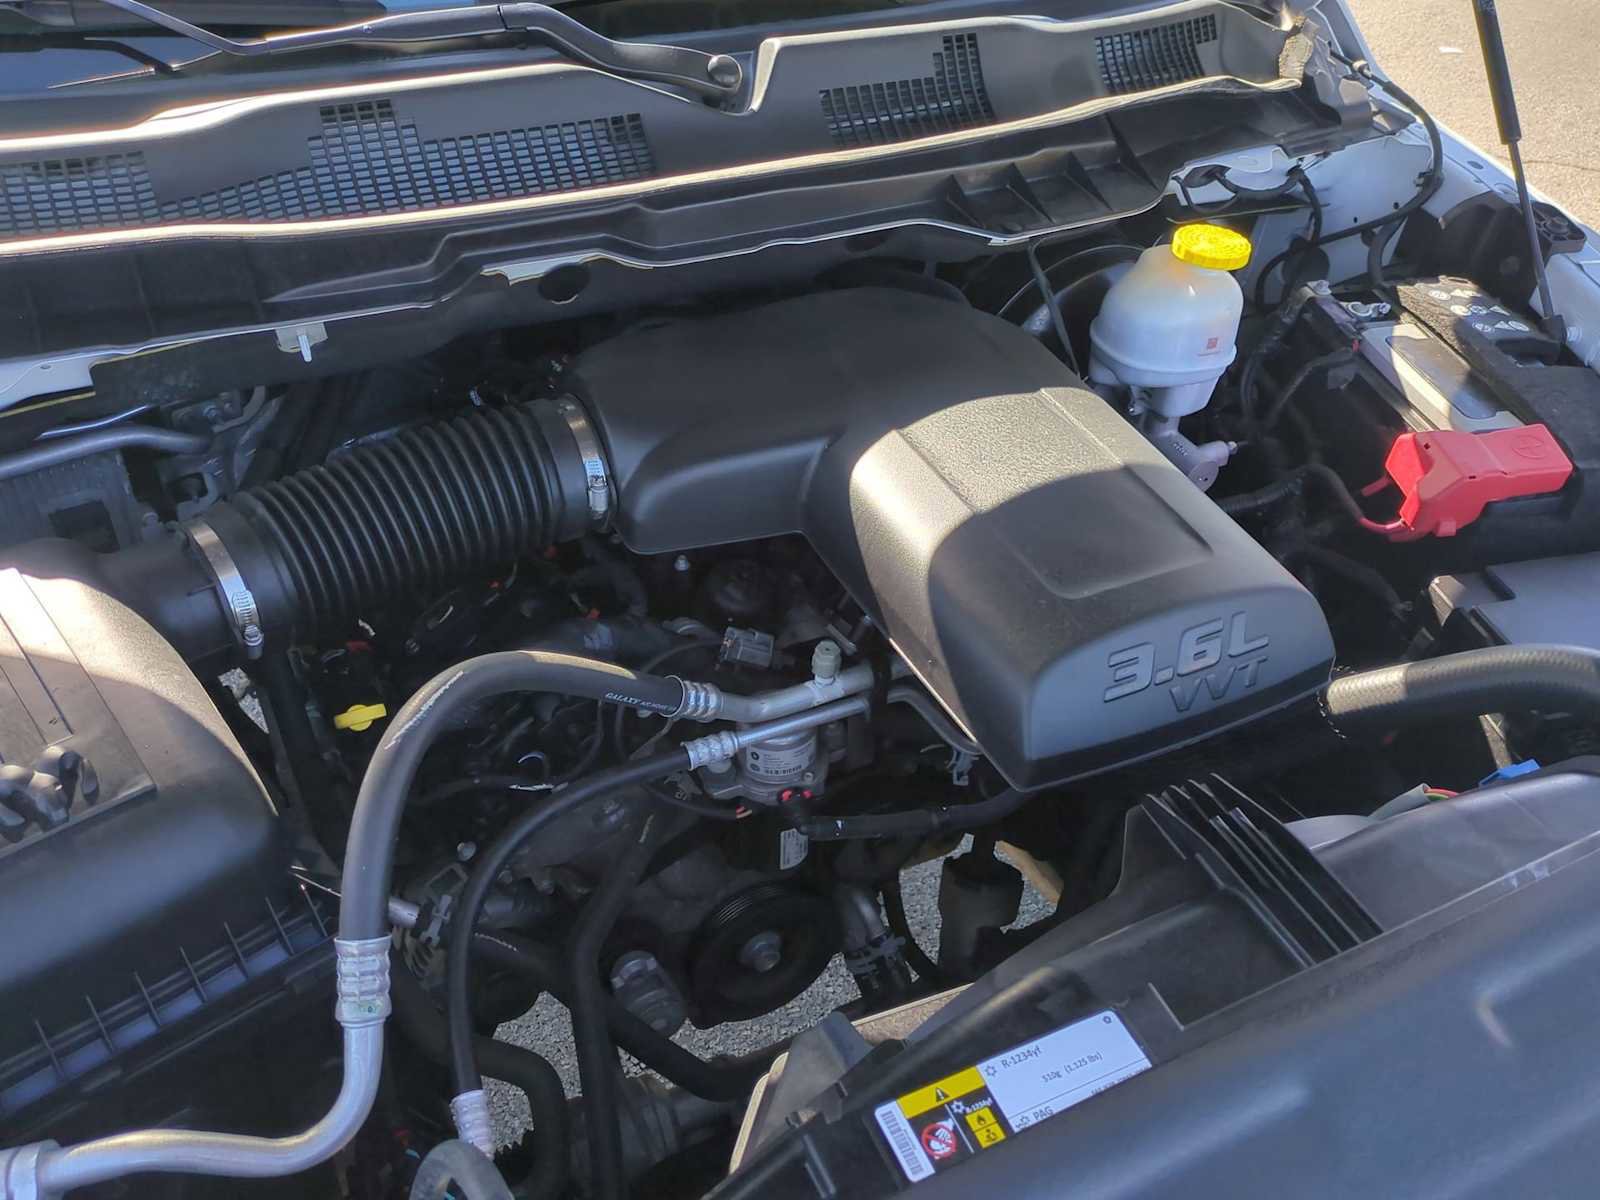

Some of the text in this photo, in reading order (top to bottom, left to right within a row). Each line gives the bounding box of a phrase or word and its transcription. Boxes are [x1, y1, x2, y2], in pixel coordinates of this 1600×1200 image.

[1103, 610, 1270, 704] 3.6L
[1169, 655, 1269, 714] VVT
[1033, 1105, 1053, 1121] PAG
